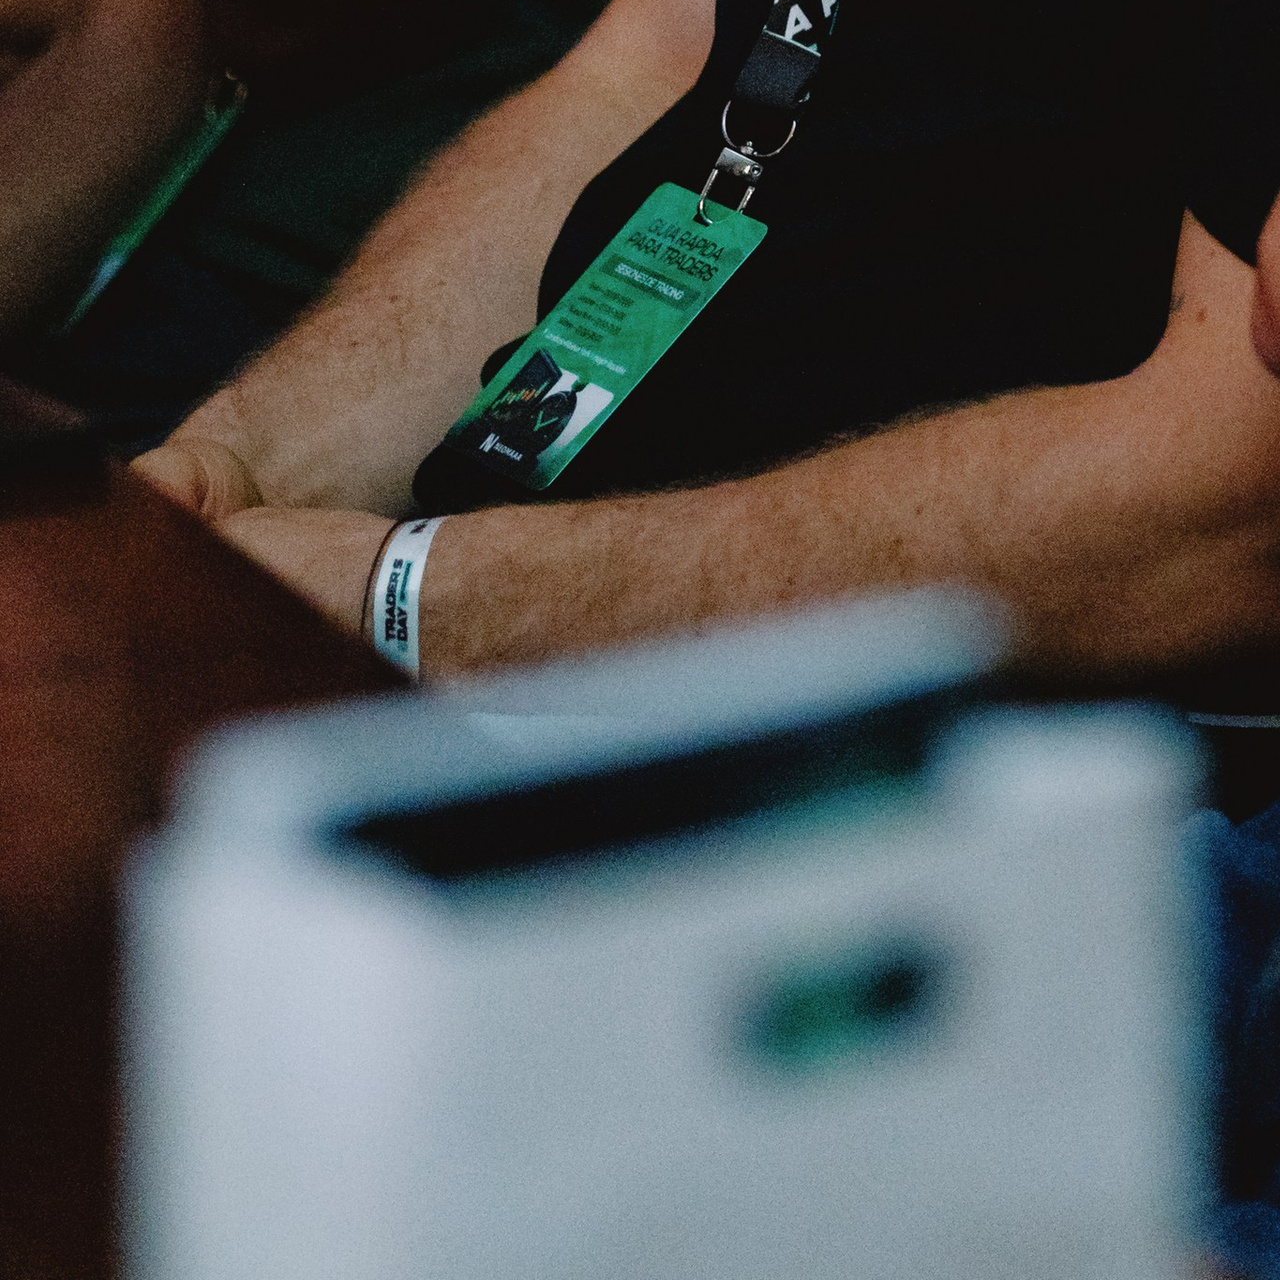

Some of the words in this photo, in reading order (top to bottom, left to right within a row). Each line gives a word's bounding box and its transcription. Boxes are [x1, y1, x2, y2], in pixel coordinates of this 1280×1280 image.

[627, 231, 662, 259] PARA
[660, 246, 719, 282] TRADERS
[397, 606, 409, 642] DAY
